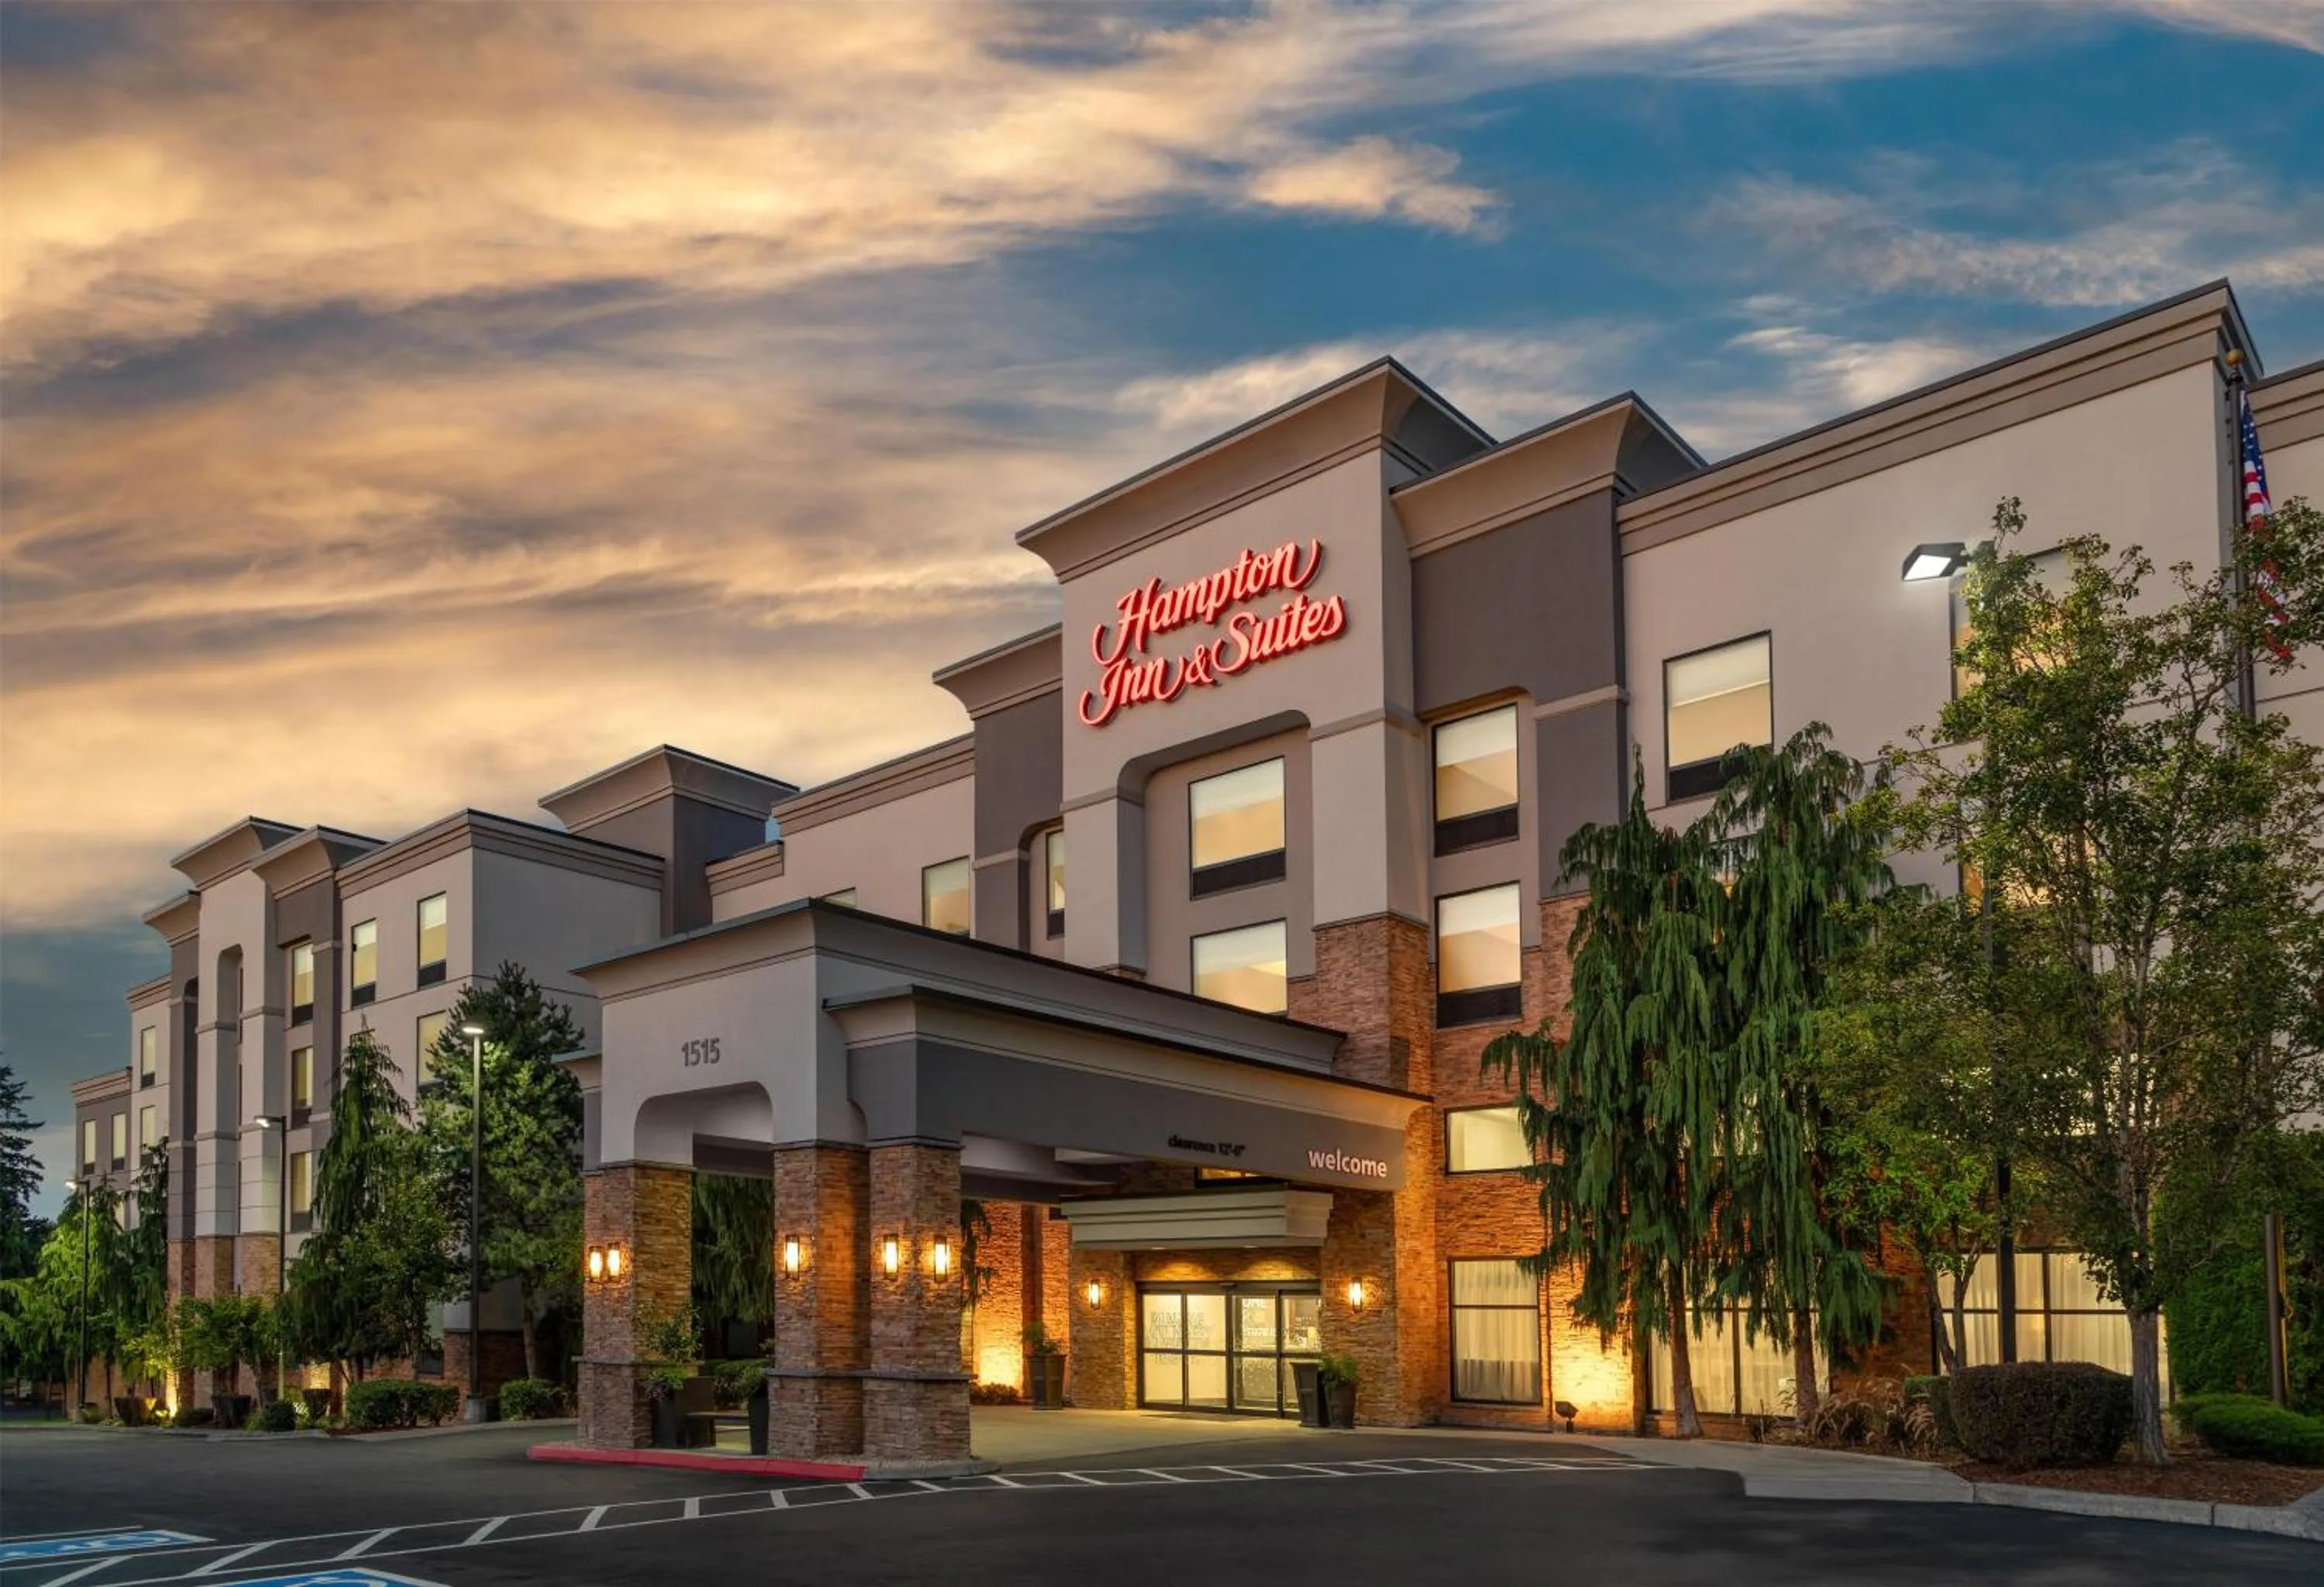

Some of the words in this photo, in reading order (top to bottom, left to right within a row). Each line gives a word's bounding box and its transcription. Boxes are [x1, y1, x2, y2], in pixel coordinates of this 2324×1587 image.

[1092, 539, 1323, 666] Hampton
[1079, 656, 1185, 726] Inn
[1184, 644, 1214, 684] &
[1211, 594, 1346, 675] Suites
[681, 1038, 720, 1067] 1515
[1308, 1148, 1388, 1178] welcome
